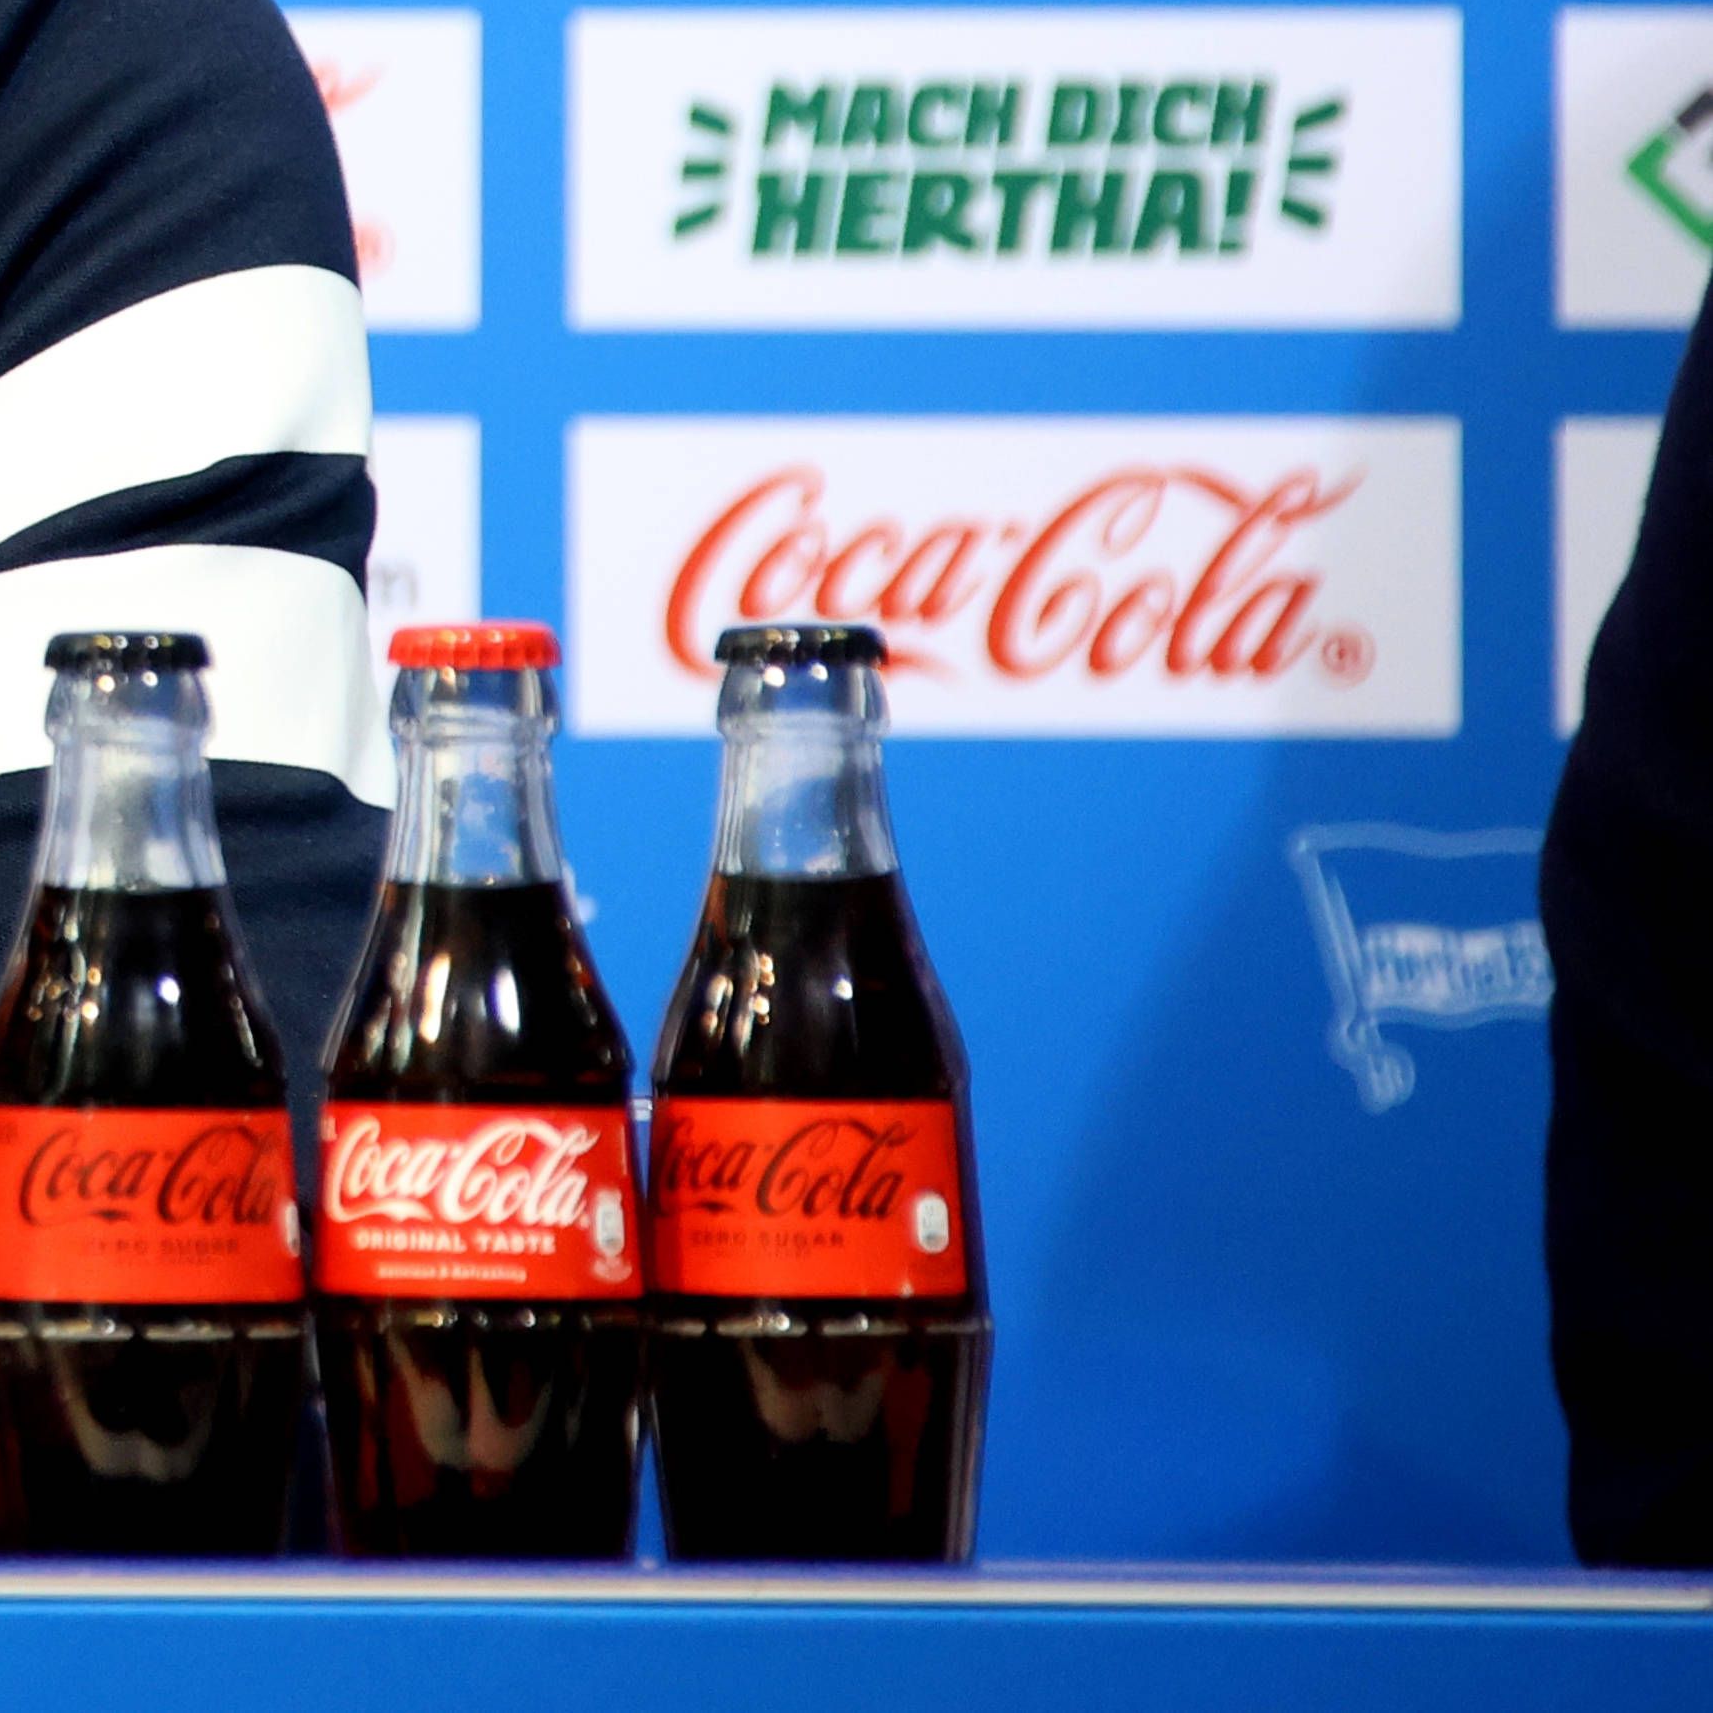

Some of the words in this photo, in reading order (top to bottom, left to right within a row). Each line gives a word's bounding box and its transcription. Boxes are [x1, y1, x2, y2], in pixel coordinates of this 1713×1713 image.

[761, 79, 1023, 148] MACH
[1044, 78, 1273, 148] DICH
[749, 164, 1259, 258] HERTHA!
[326, 1115, 601, 1229] Coca-Cola
[351, 1228, 467, 1253] ORIGINAL
[475, 1229, 557, 1255] TASTE
